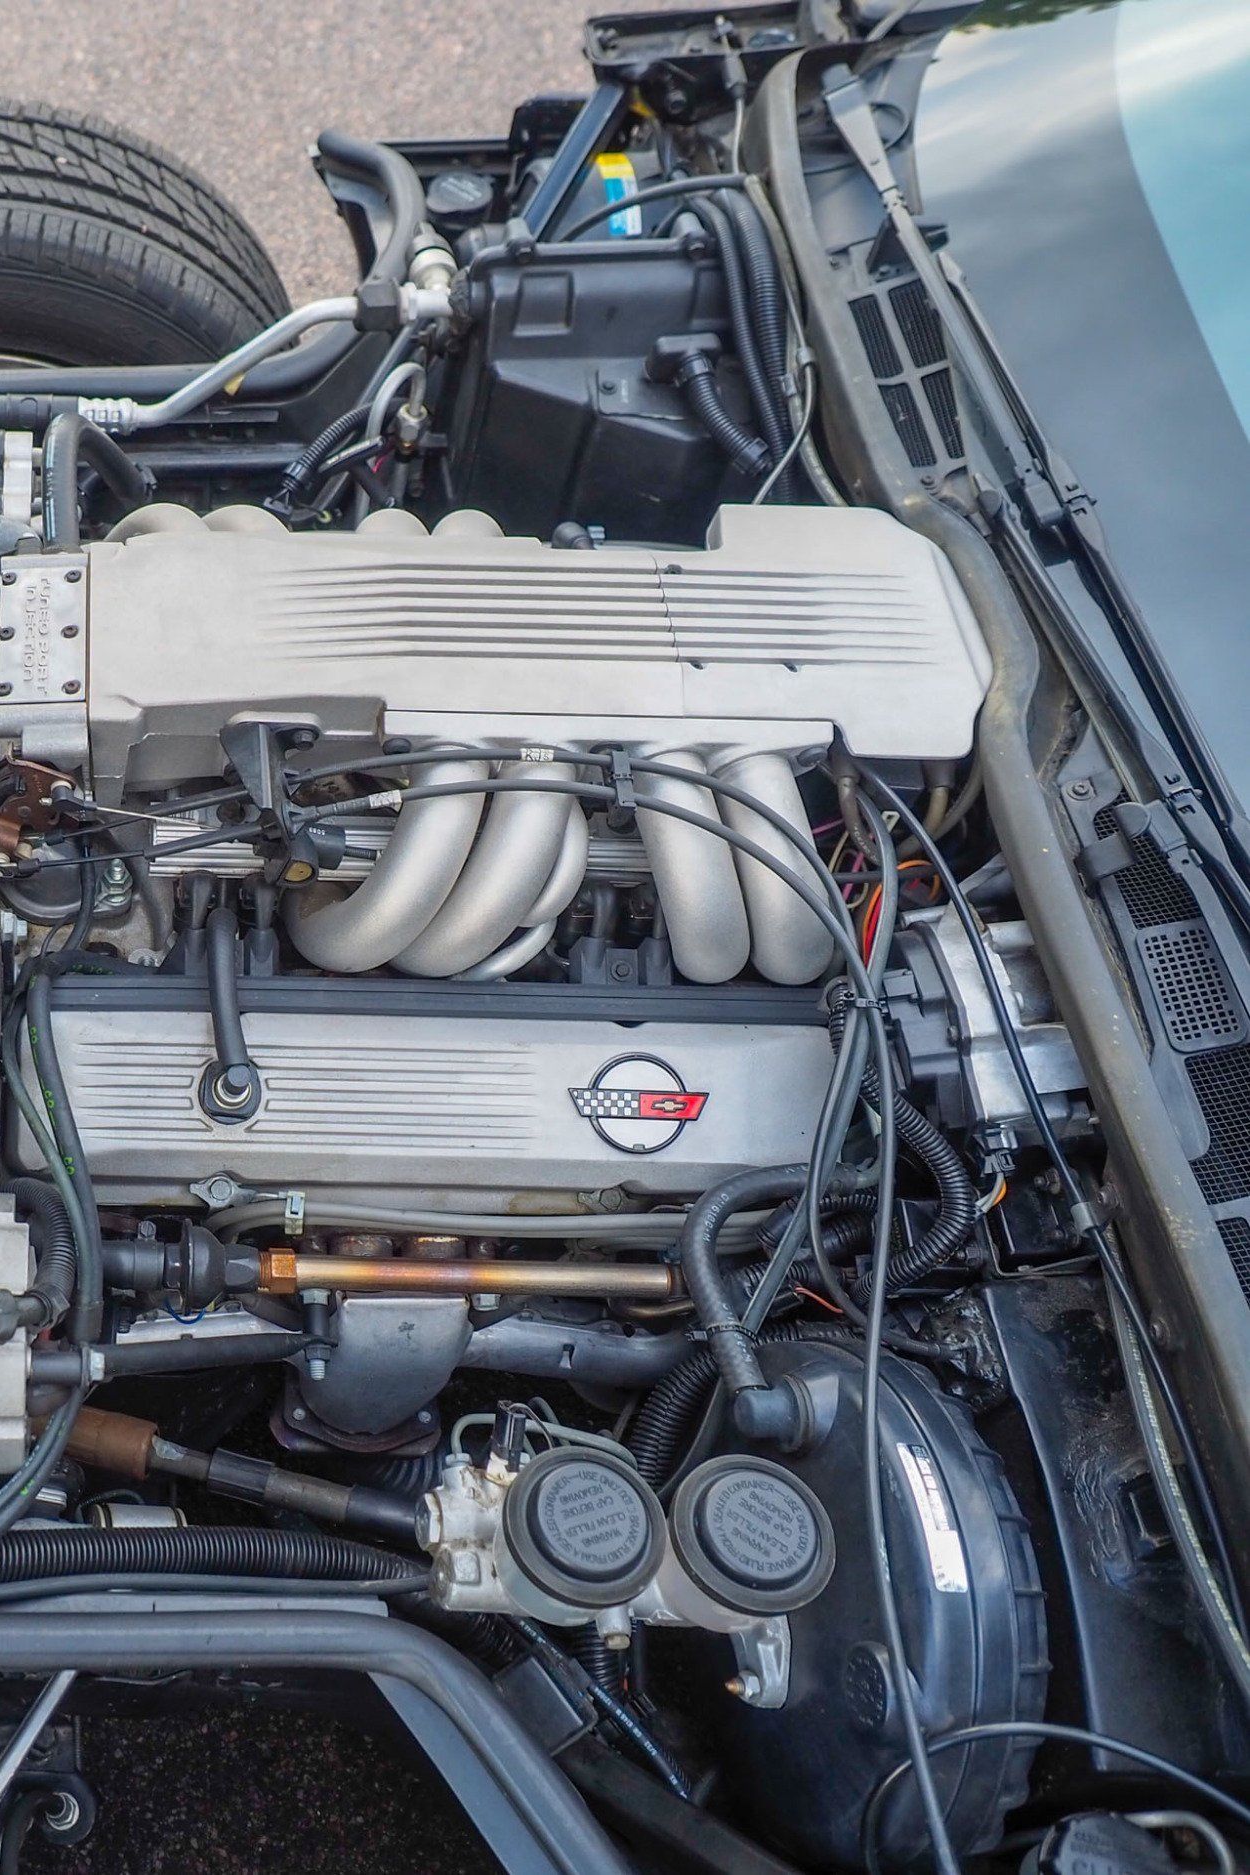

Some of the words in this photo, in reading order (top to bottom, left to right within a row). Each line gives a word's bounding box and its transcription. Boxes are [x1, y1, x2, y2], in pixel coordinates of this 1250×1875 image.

[559, 1484, 604, 1506] REMOVING
[596, 1496, 614, 1509] CAP
[561, 1502, 595, 1519] BEFORE
[738, 1498, 773, 1525] BEFORE
[749, 1490, 794, 1523] REMOVING
[565, 1520, 596, 1537] FILLER
[597, 1512, 626, 1528] CLEAN
[628, 1515, 640, 1546] BRAKE
[726, 1508, 758, 1534] FILLER
[773, 1523, 793, 1537] CAP
[581, 1527, 622, 1548] WARNING
[731, 1527, 771, 1558] WARNING
[759, 1531, 789, 1554] CLEAN
[738, 1553, 765, 1572] FLUID
[768, 1553, 797, 1572] BRAKE
